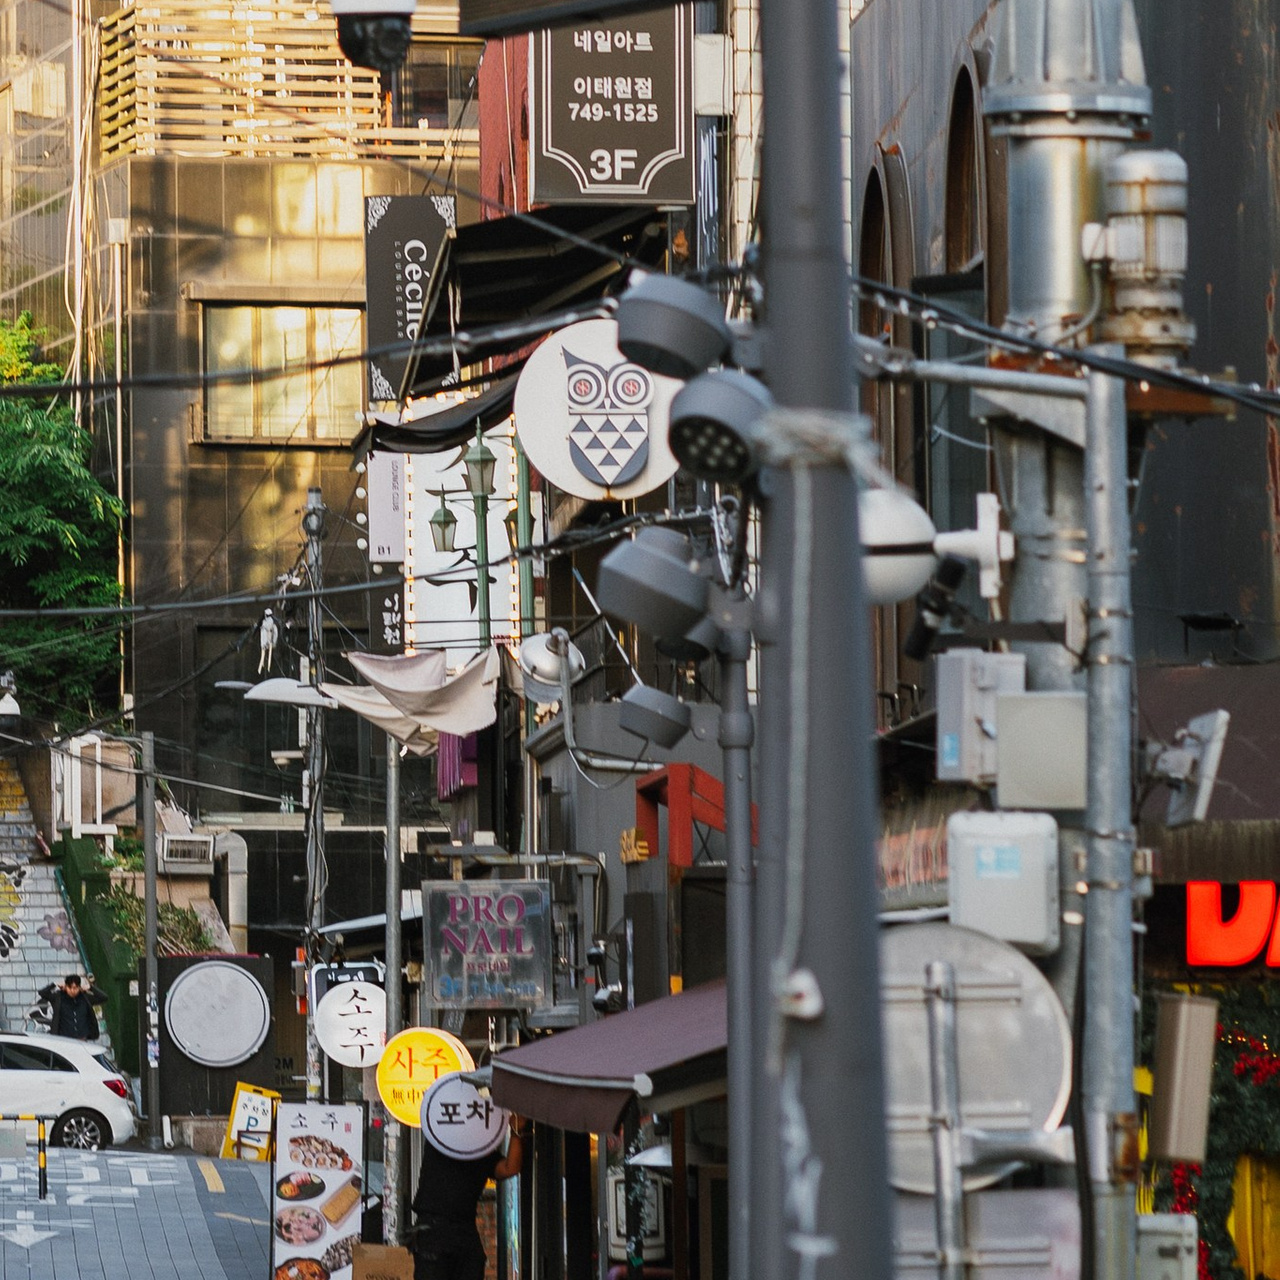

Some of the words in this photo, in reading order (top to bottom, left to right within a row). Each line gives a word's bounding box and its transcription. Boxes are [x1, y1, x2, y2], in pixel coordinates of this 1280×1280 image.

[572, 30, 654, 55] 네일아트
[572, 75, 654, 101] 이태원점
[567, 103, 660, 123] 749-1525
[589, 148, 639, 181] 3F
[447, 894, 526, 926] PRO
[440, 926, 535, 956] NAIL
[338, 988, 375, 1063] 소주
[389, 1046, 451, 1079] 사주
[245, 1115, 259, 1132] P
[436, 1100, 494, 1130] 포차
